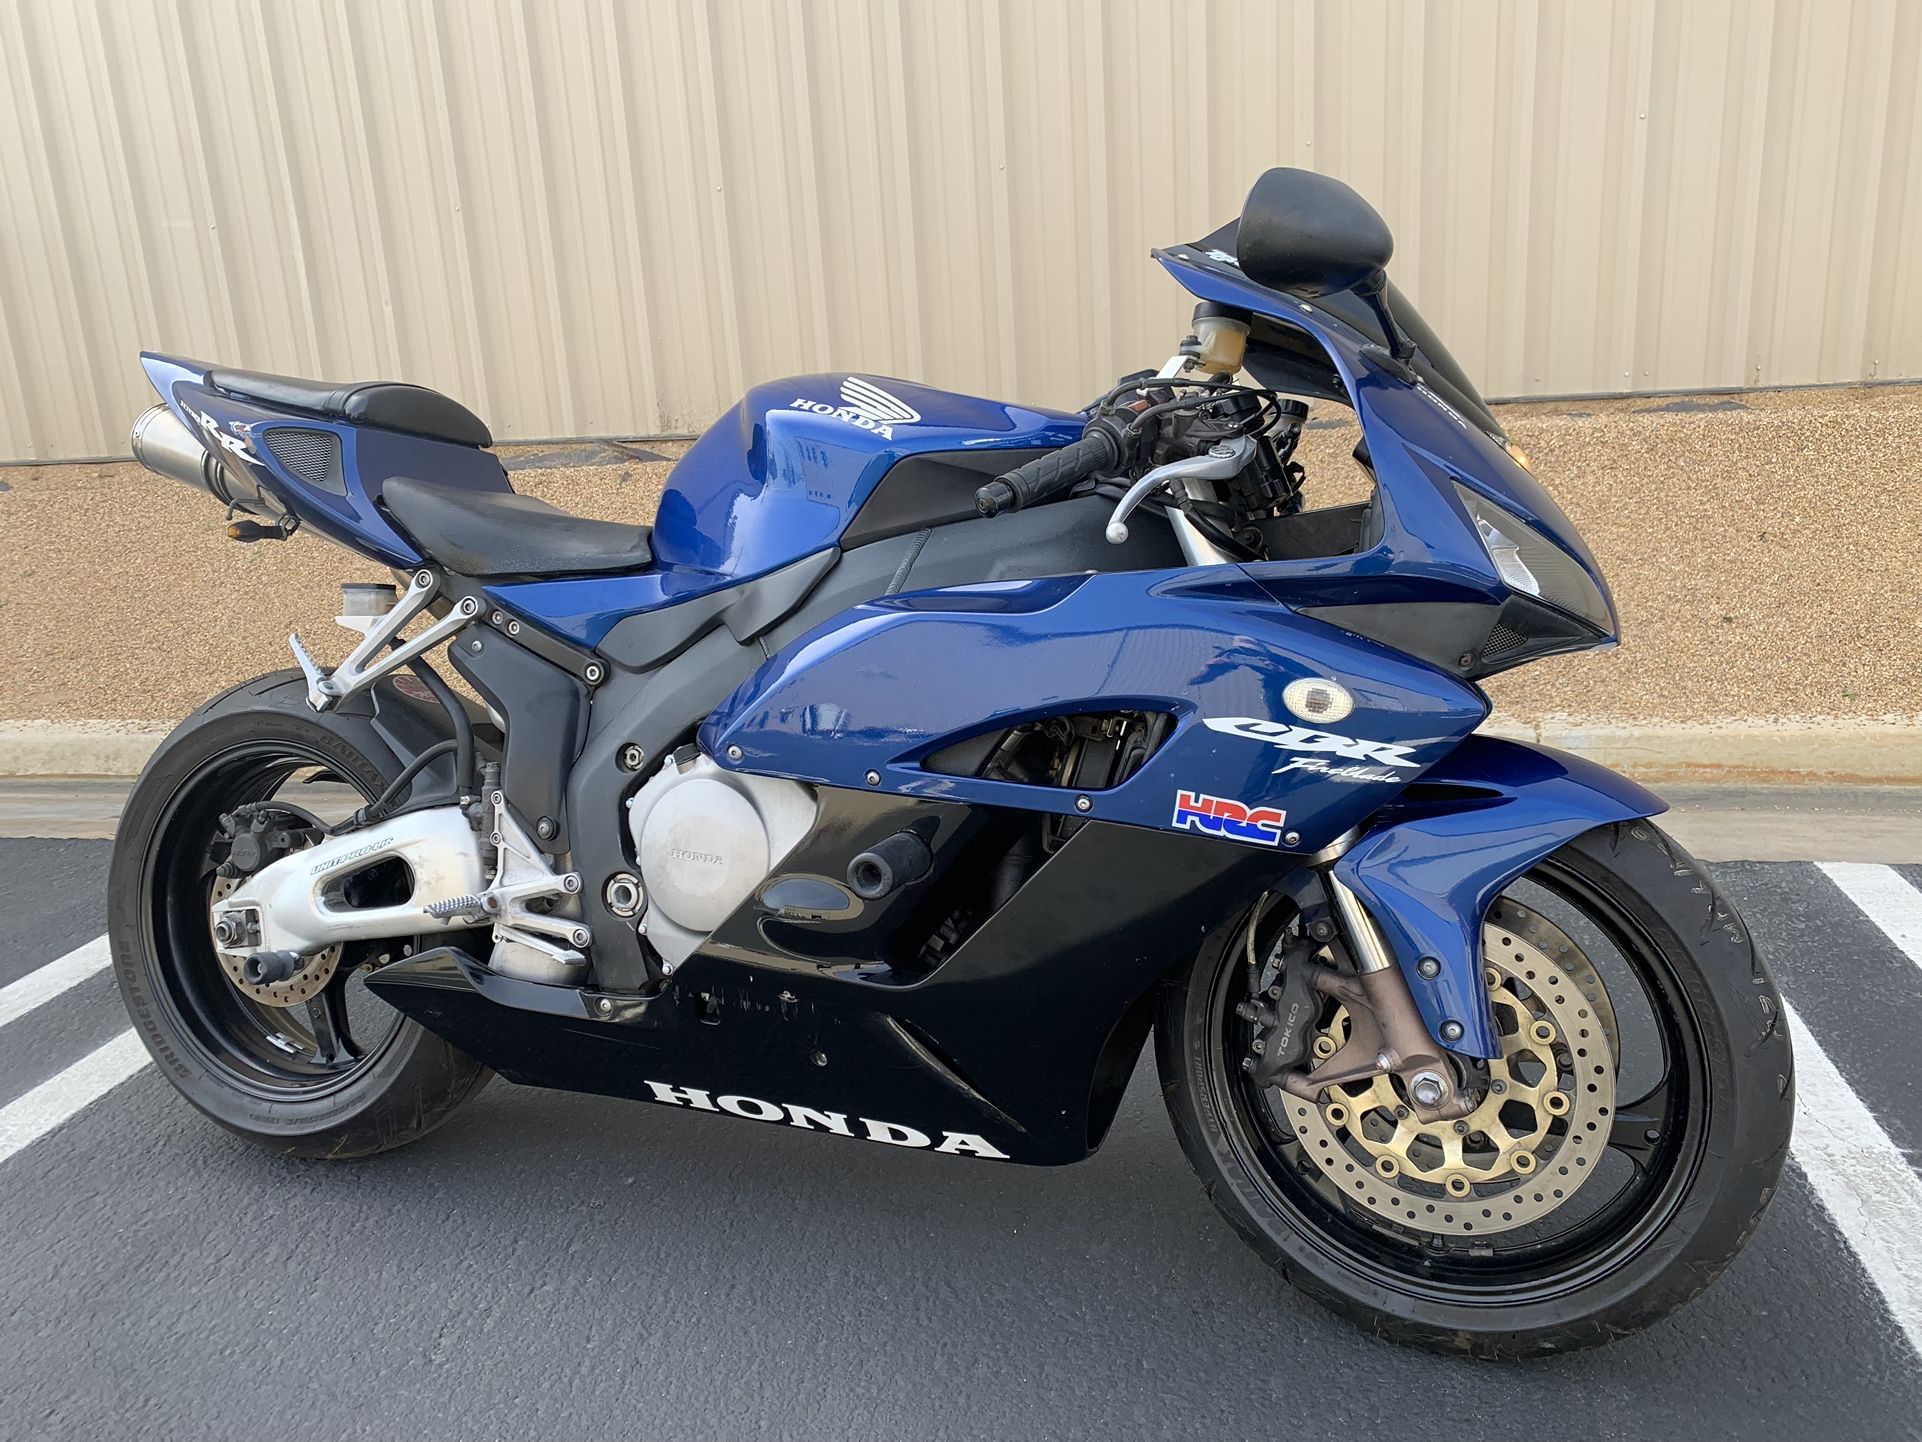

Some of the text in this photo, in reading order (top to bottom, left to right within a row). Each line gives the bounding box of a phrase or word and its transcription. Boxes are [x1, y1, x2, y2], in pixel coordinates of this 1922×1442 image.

[789, 398, 894, 441] HONDA
[1202, 717, 1421, 767] CBR
[1271, 756, 1401, 783] Fireblade
[1171, 789, 1287, 846] HRC
[671, 848, 727, 865] HONDA
[1277, 1003, 1300, 1057] TOKICO
[643, 1080, 1011, 1159] HONDA
